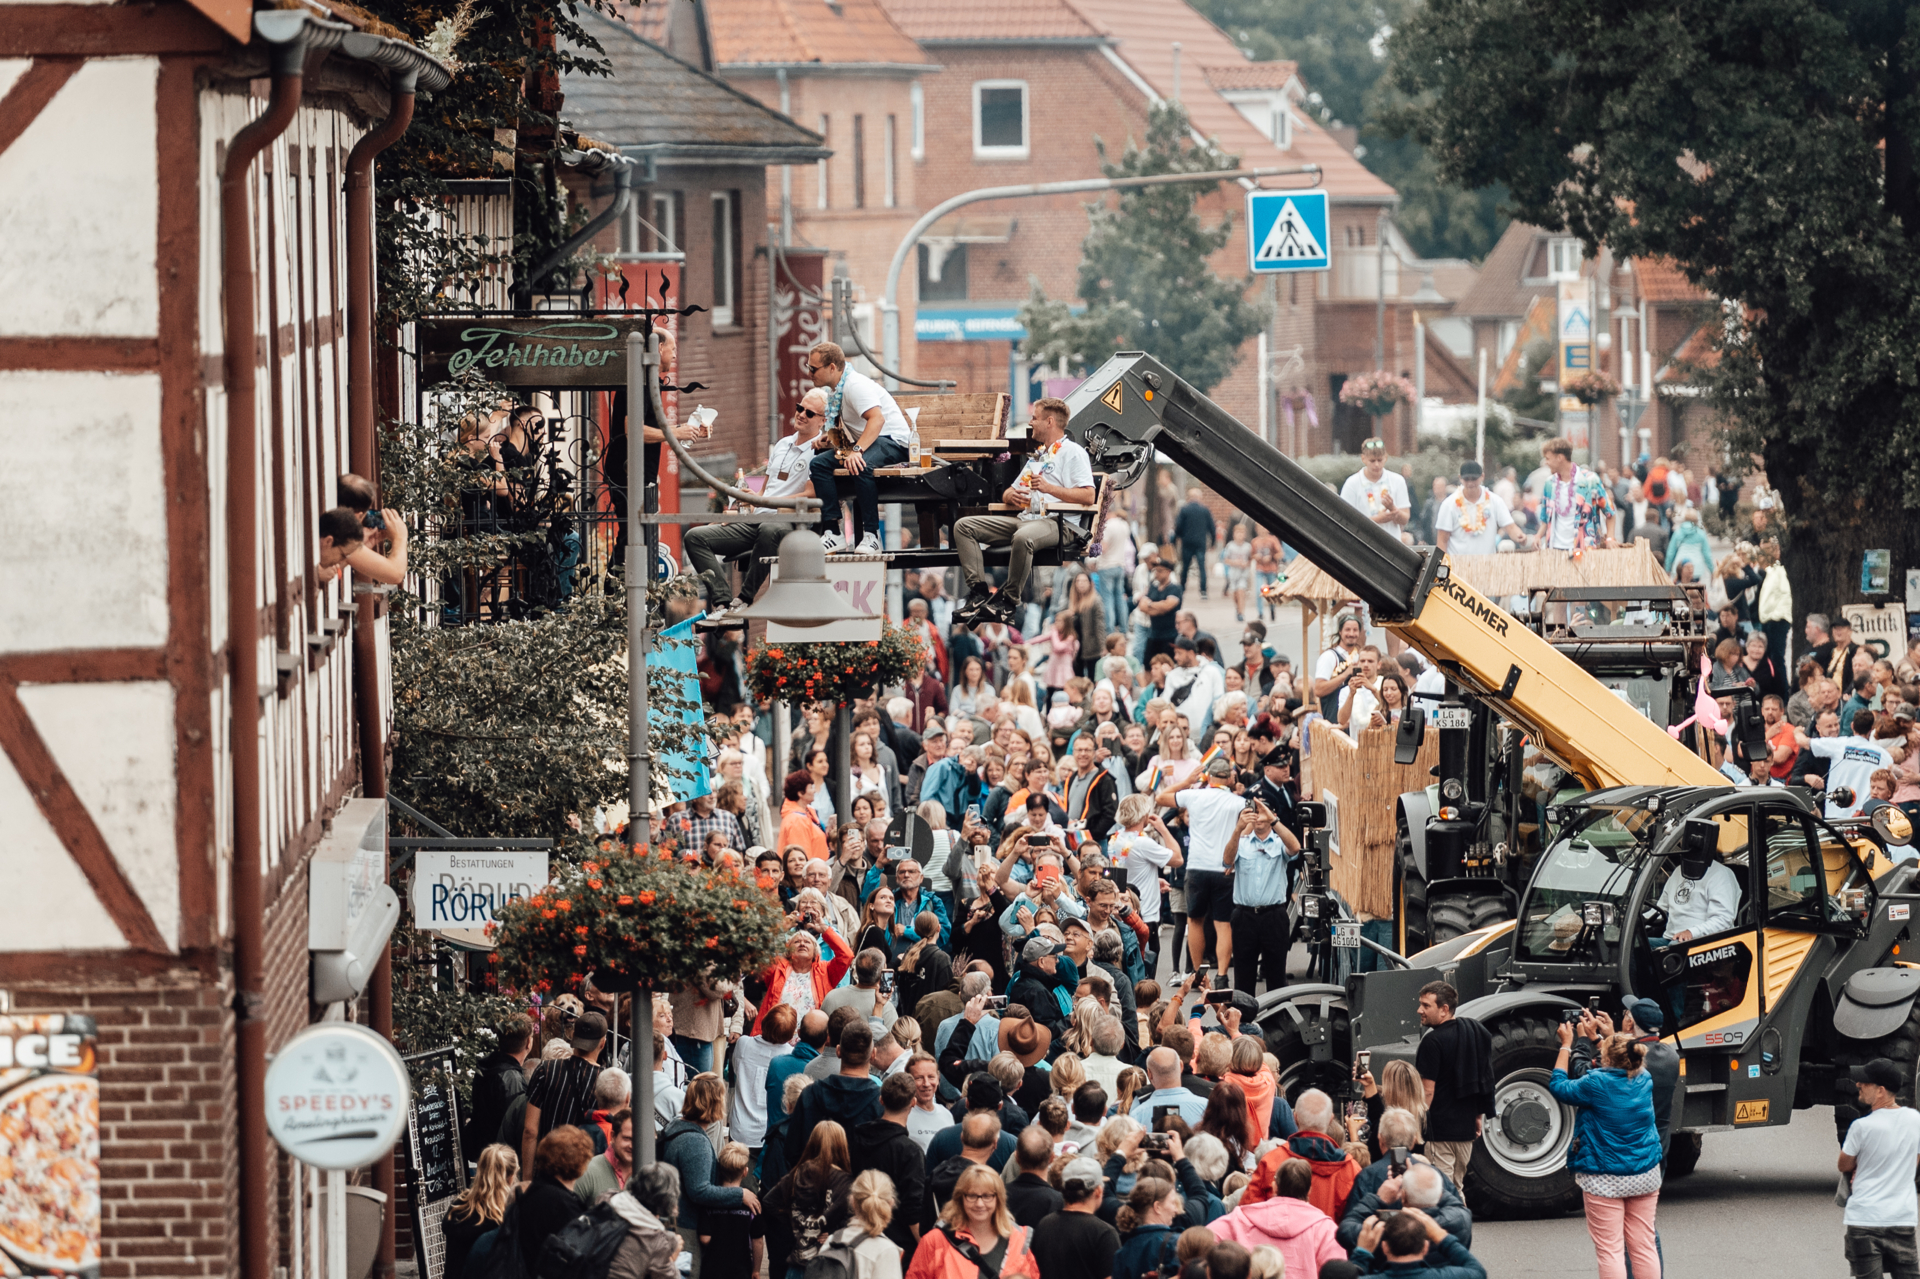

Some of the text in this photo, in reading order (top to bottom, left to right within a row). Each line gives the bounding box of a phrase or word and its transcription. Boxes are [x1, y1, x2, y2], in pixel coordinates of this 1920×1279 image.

[448, 322, 619, 374] Fehlhaber
[1442, 578, 1509, 638] KRAMER
[1849, 611, 1898, 633] Antik
[1437, 720, 1466, 728] KS 186
[1443, 711, 1454, 719] LG
[450, 855, 514, 868] BESTATTUNGEN
[432, 884, 522, 921] RÖRU
[1337, 928, 1346, 936] LG
[1688, 945, 1737, 968] KRAMER
[1705, 1031, 1744, 1045] 5509
[278, 1094, 393, 1112] SPEEDY'S
